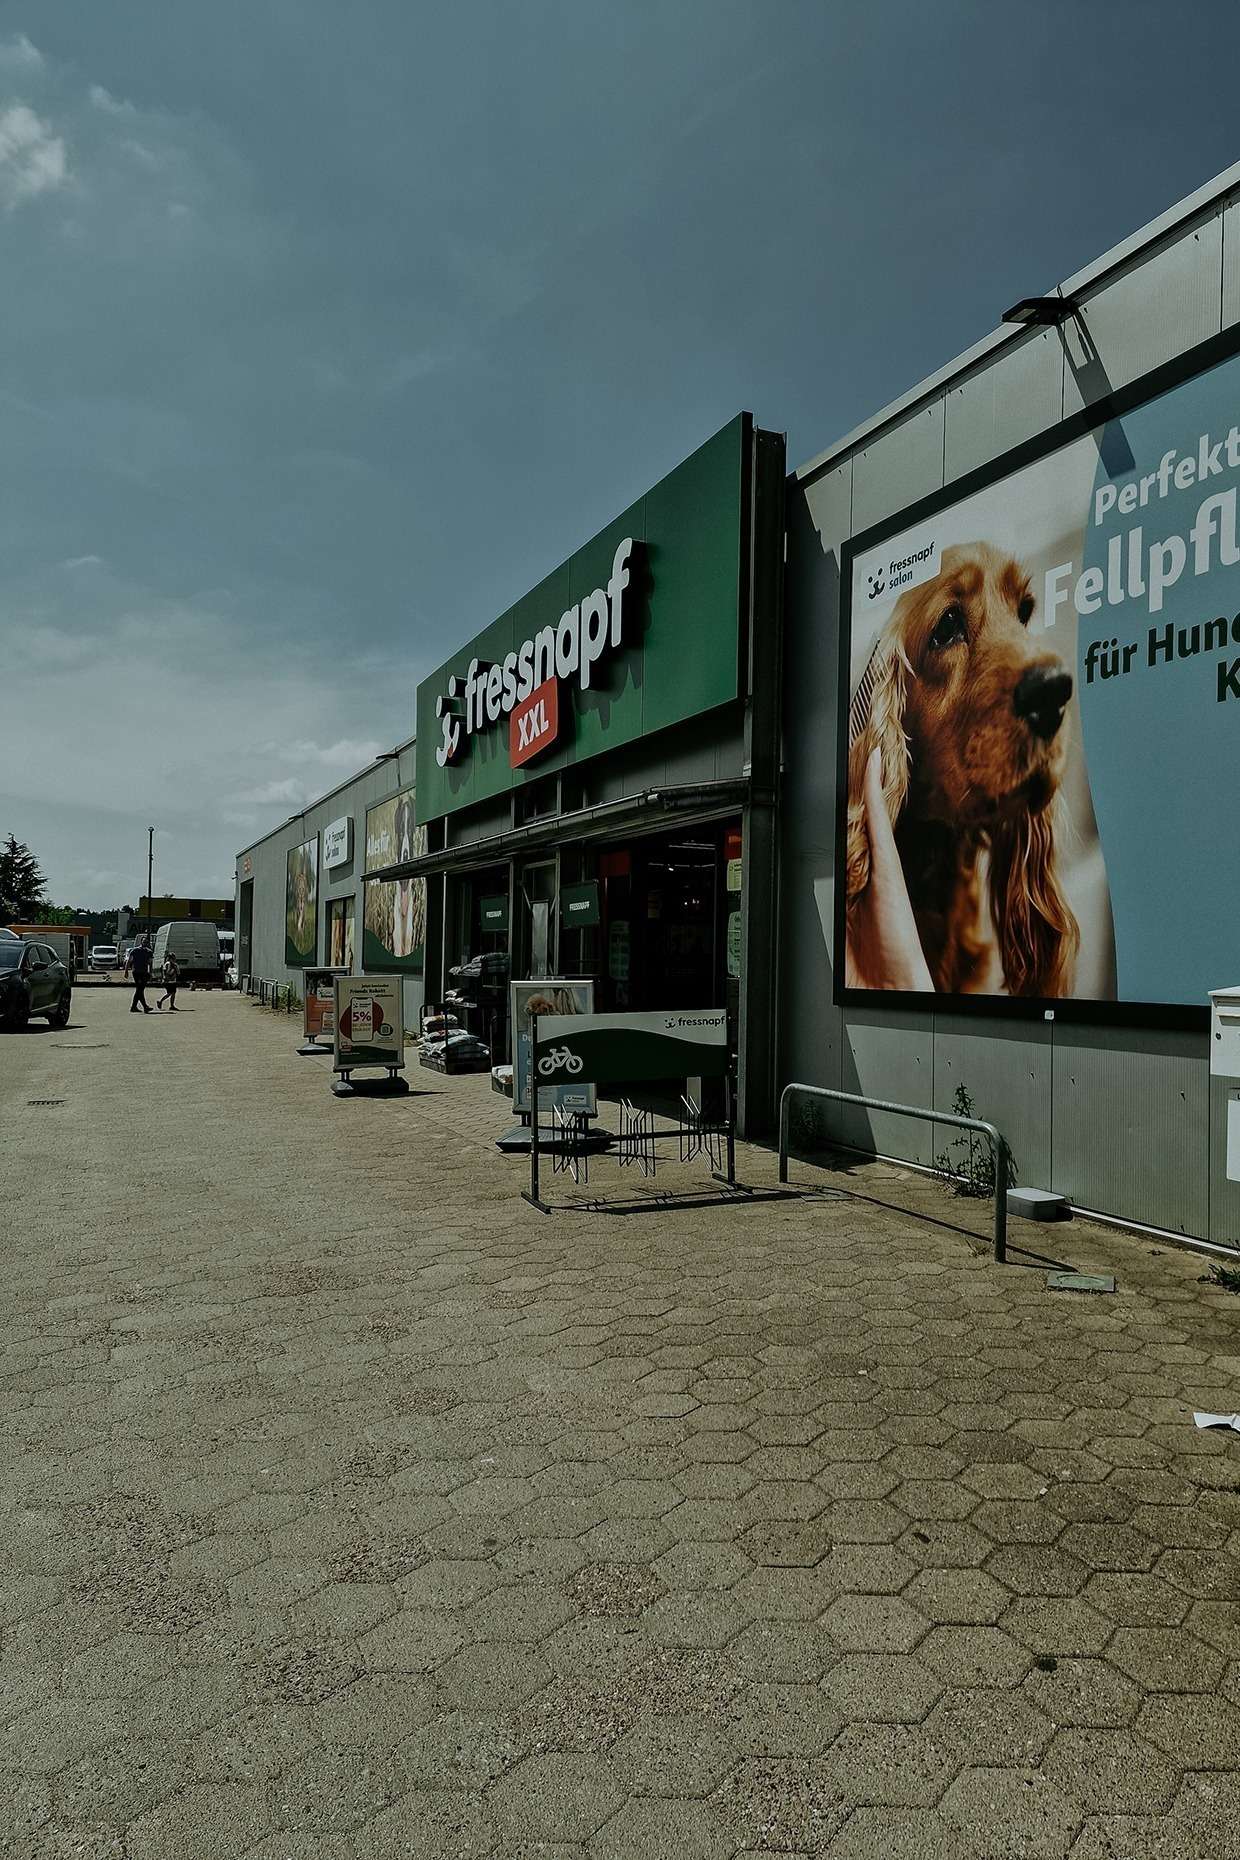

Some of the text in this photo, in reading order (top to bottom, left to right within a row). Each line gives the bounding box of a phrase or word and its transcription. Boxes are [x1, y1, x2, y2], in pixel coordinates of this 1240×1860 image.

[889, 541, 935, 575] fressnapf
[889, 571, 913, 590] salon
[465, 537, 633, 734] fressnapf
[1085, 638, 1138, 684] für
[518, 699, 549, 751] XXL
[353, 1011, 372, 1022] 5%
[678, 1015, 726, 1027] fressnapf
